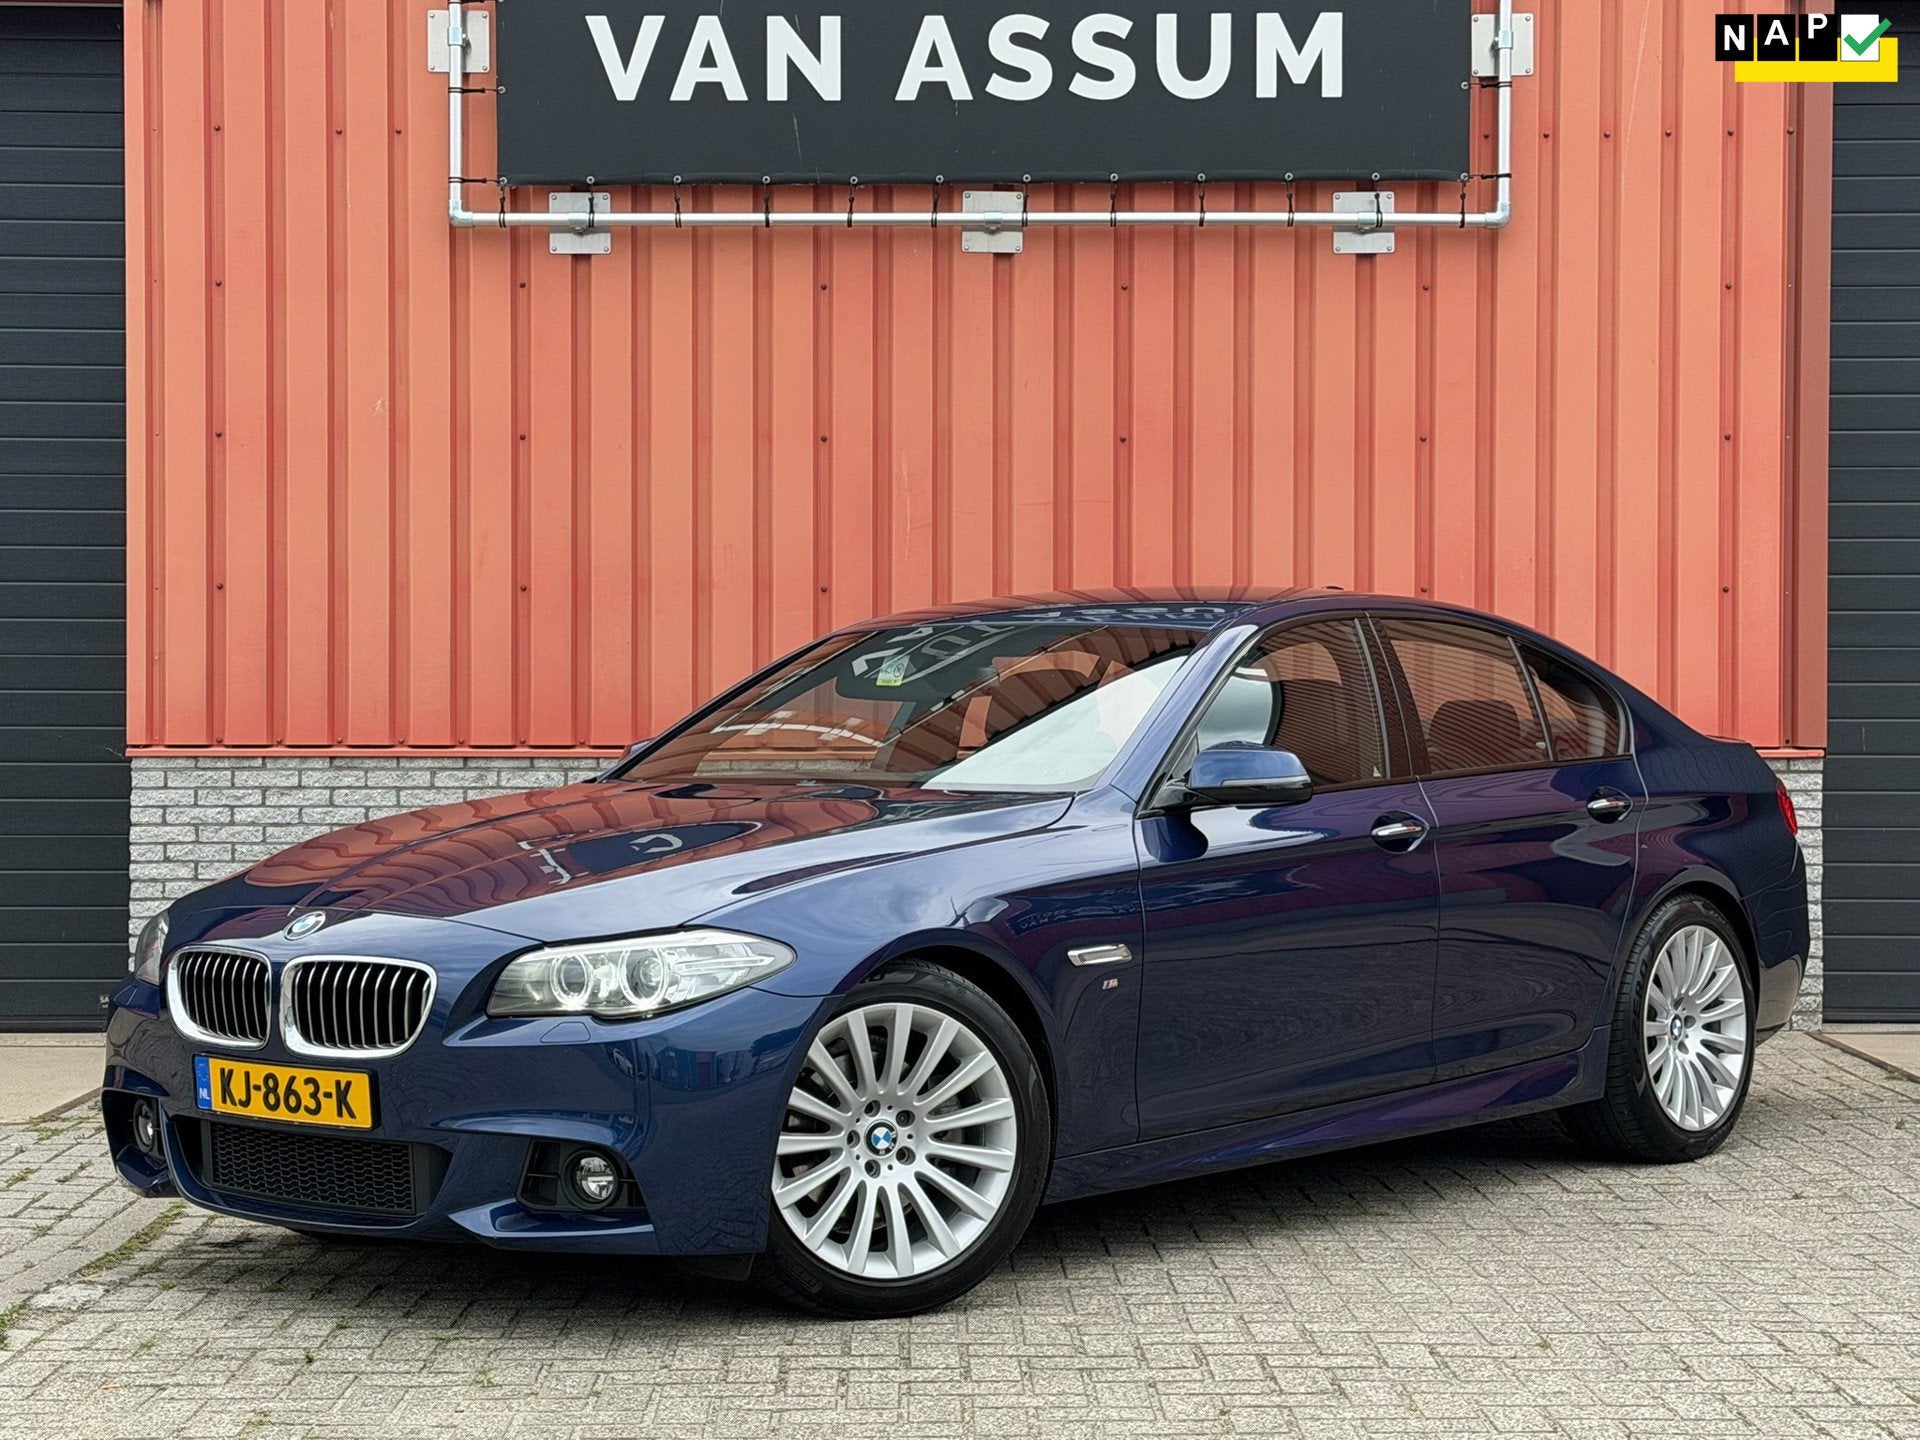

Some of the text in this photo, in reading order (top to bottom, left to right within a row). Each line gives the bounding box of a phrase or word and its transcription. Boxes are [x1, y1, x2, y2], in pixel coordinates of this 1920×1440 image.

[584, 12, 1343, 101] VAN ASSUM
[199, 1087, 210, 1100] NL
[219, 1067, 357, 1120] KJ-863-K
